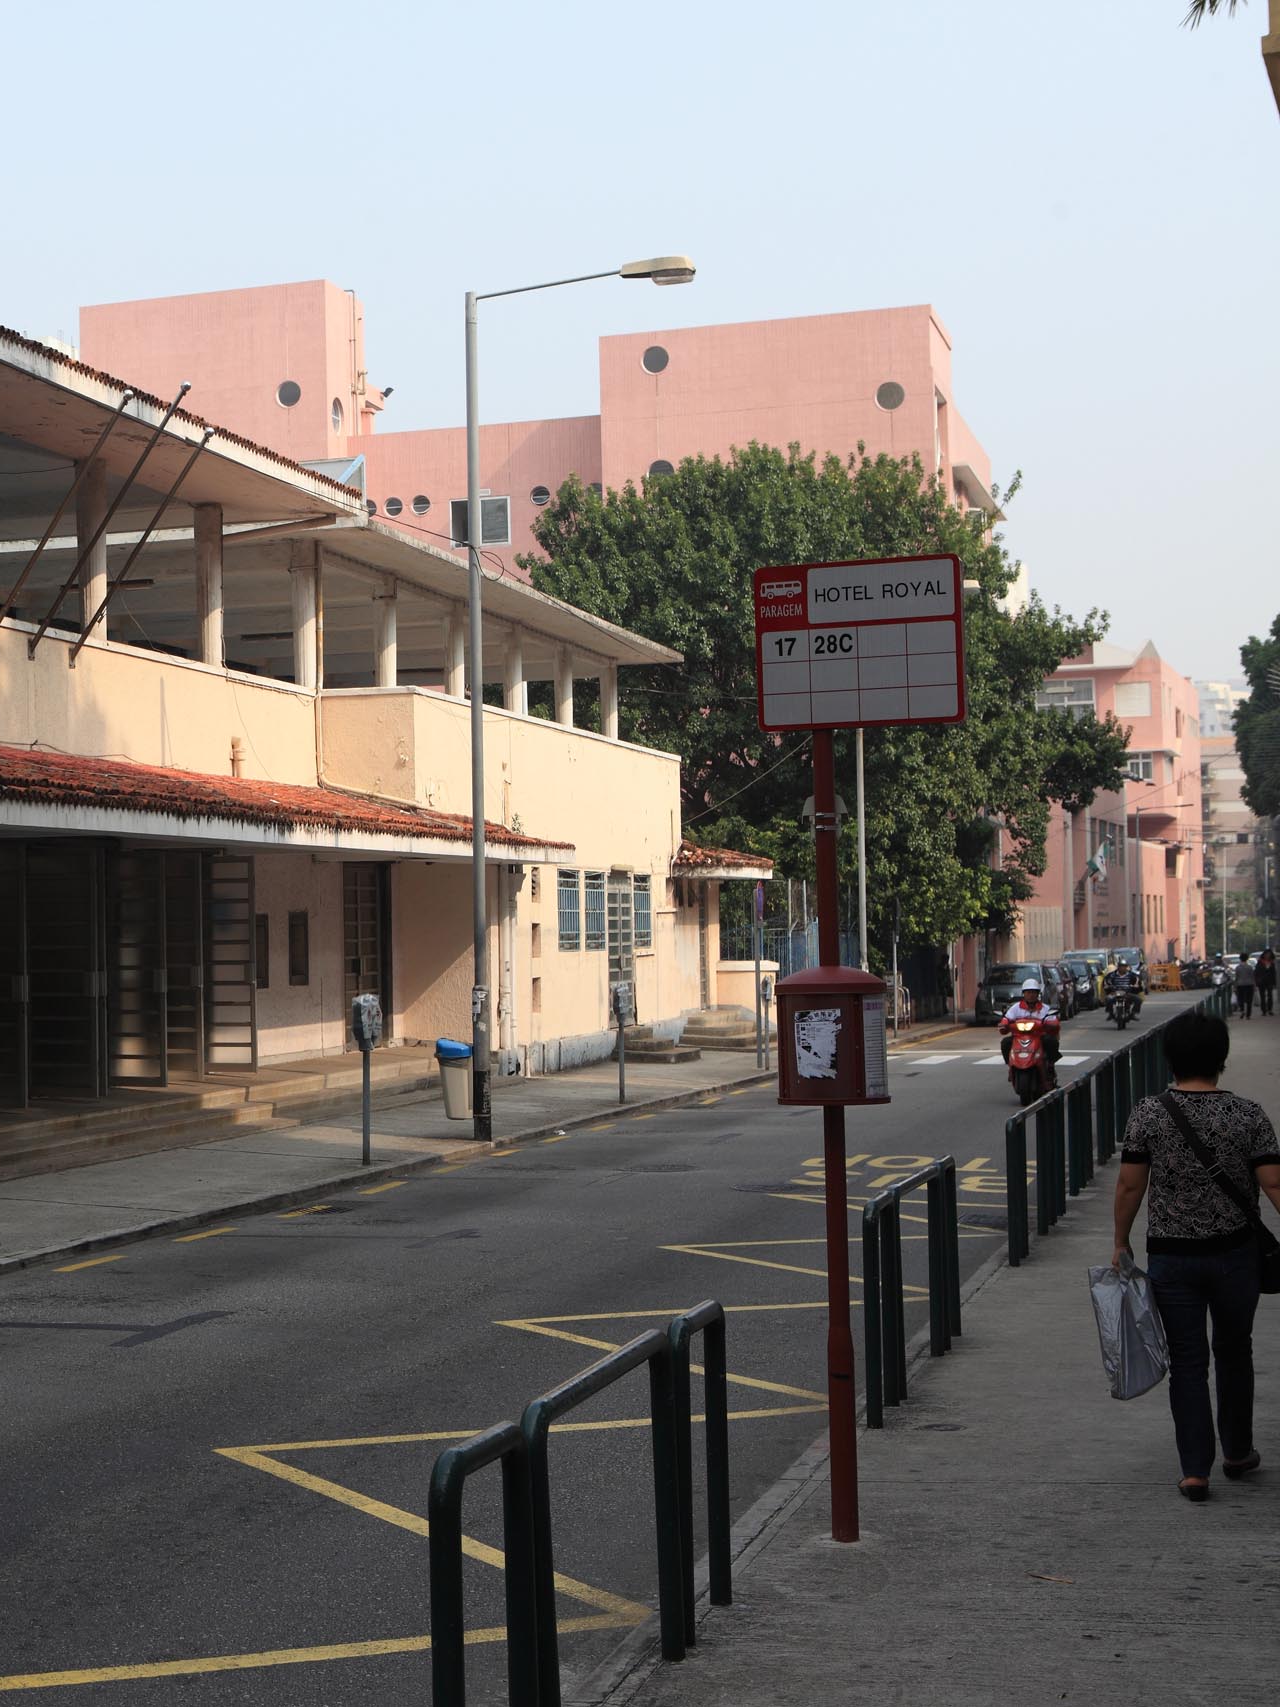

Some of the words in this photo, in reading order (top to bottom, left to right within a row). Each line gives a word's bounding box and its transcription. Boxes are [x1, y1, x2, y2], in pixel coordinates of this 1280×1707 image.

[814, 587, 873, 603] HOTEL
[882, 582, 946, 599] ROYAL
[760, 603, 803, 618] PARAGEM
[774, 638, 797, 656] 17
[814, 634, 853, 654] 28C
[800, 1154, 1038, 1174] TOP
